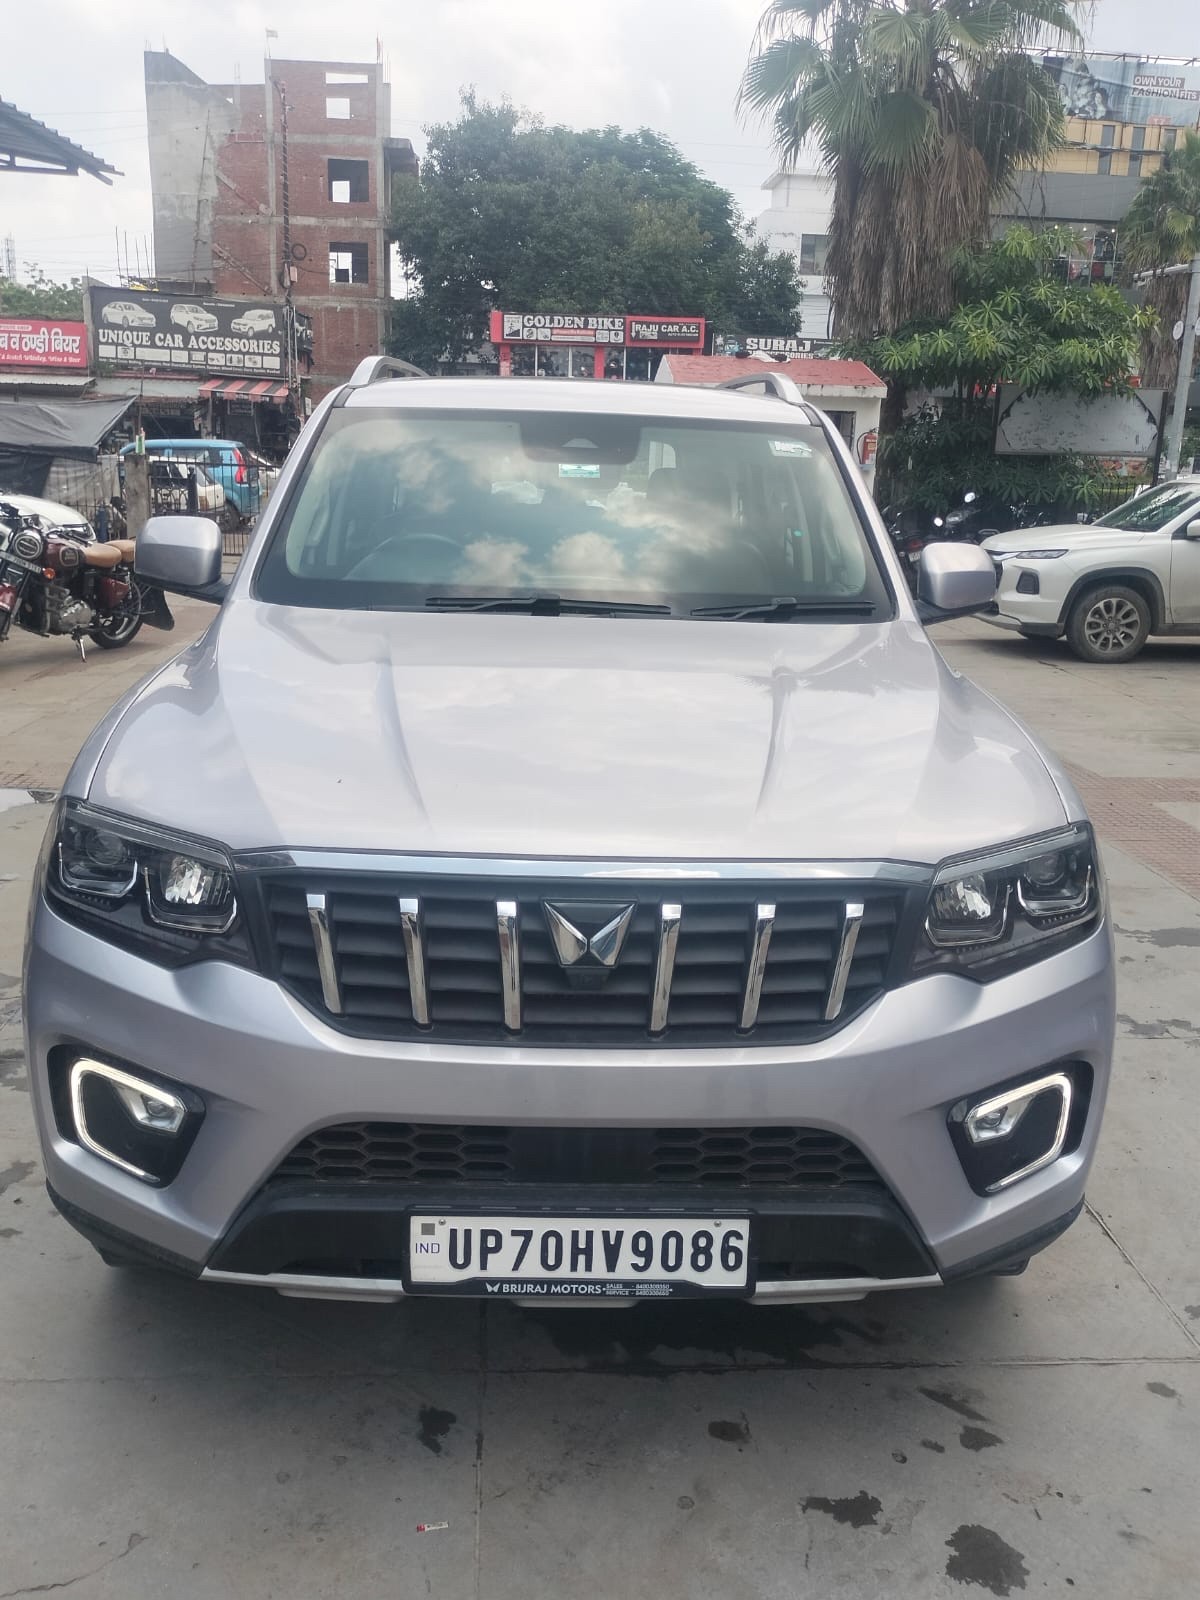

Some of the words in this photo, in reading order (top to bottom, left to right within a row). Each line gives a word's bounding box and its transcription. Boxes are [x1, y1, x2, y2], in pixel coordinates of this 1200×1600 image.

[1134, 76, 1157, 86] OWN
[1158, 77, 1182, 88] YOUR
[1132, 87, 1177, 98] FASHION
[1178, 89, 1198, 100] FITS
[523, 315, 585, 329] GOLDEN
[588, 317, 624, 330] BIKE
[635, 324, 659, 332] RAJU
[681, 325, 699, 333] A.C.
[50, 328, 81, 354] बियर
[99, 329, 150, 347] UNIQUE
[155, 335, 184, 348] CAR
[188, 335, 281, 354] ACCESSORIES
[746, 338, 811, 352] SURAJ
[415, 1242, 440, 1254] IND
[449, 1228, 744, 1273] UP70HV9086
[502, 1283, 547, 1295] BRIJRAJ
[551, 1284, 601, 1294] MOTORS
